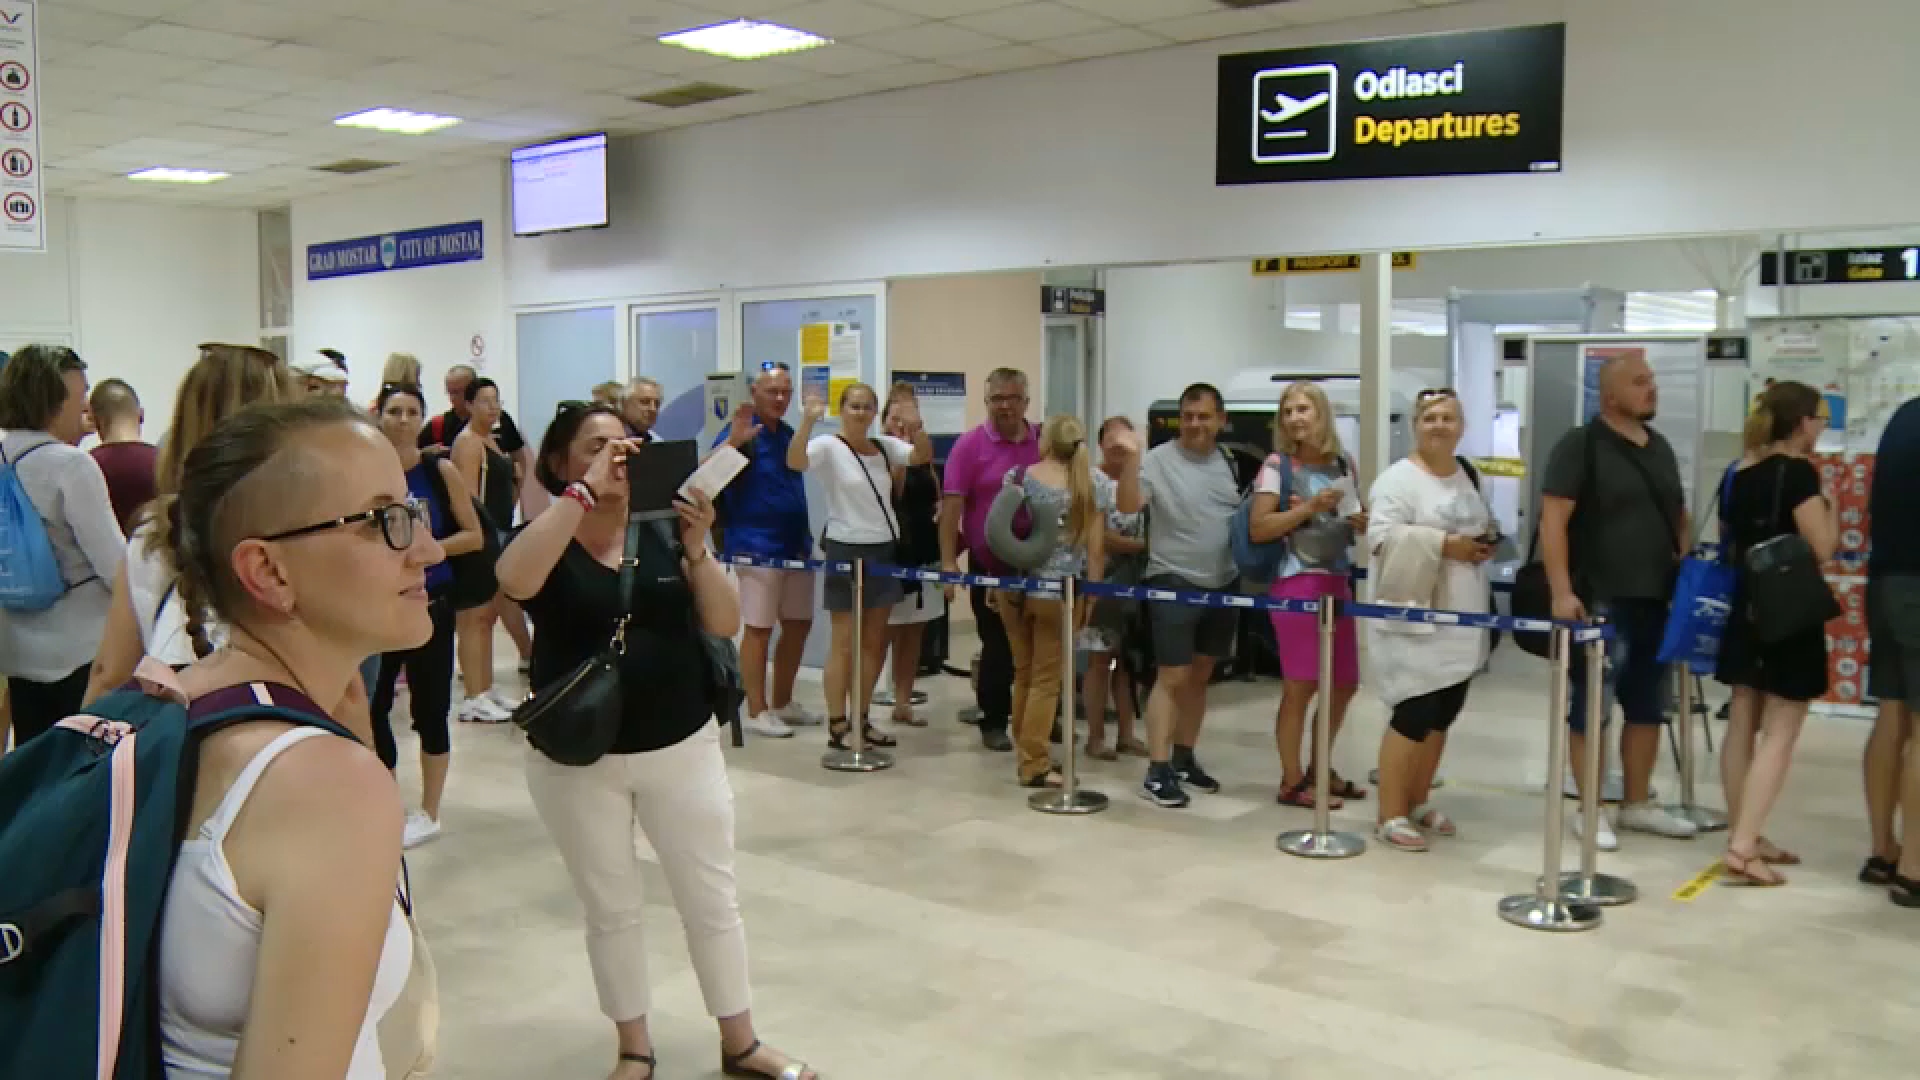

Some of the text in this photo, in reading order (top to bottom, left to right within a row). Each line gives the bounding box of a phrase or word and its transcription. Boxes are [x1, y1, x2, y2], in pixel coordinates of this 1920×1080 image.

[1354, 61, 1464, 101] Odlasci
[1354, 112, 1521, 147] Departures
[337, 245, 377, 267] MOSTAR
[400, 239, 422, 261] CITY
[424, 236, 437, 257] OF
[439, 230, 481, 254] MOSTAR
[1900, 248, 1918, 279] 1
